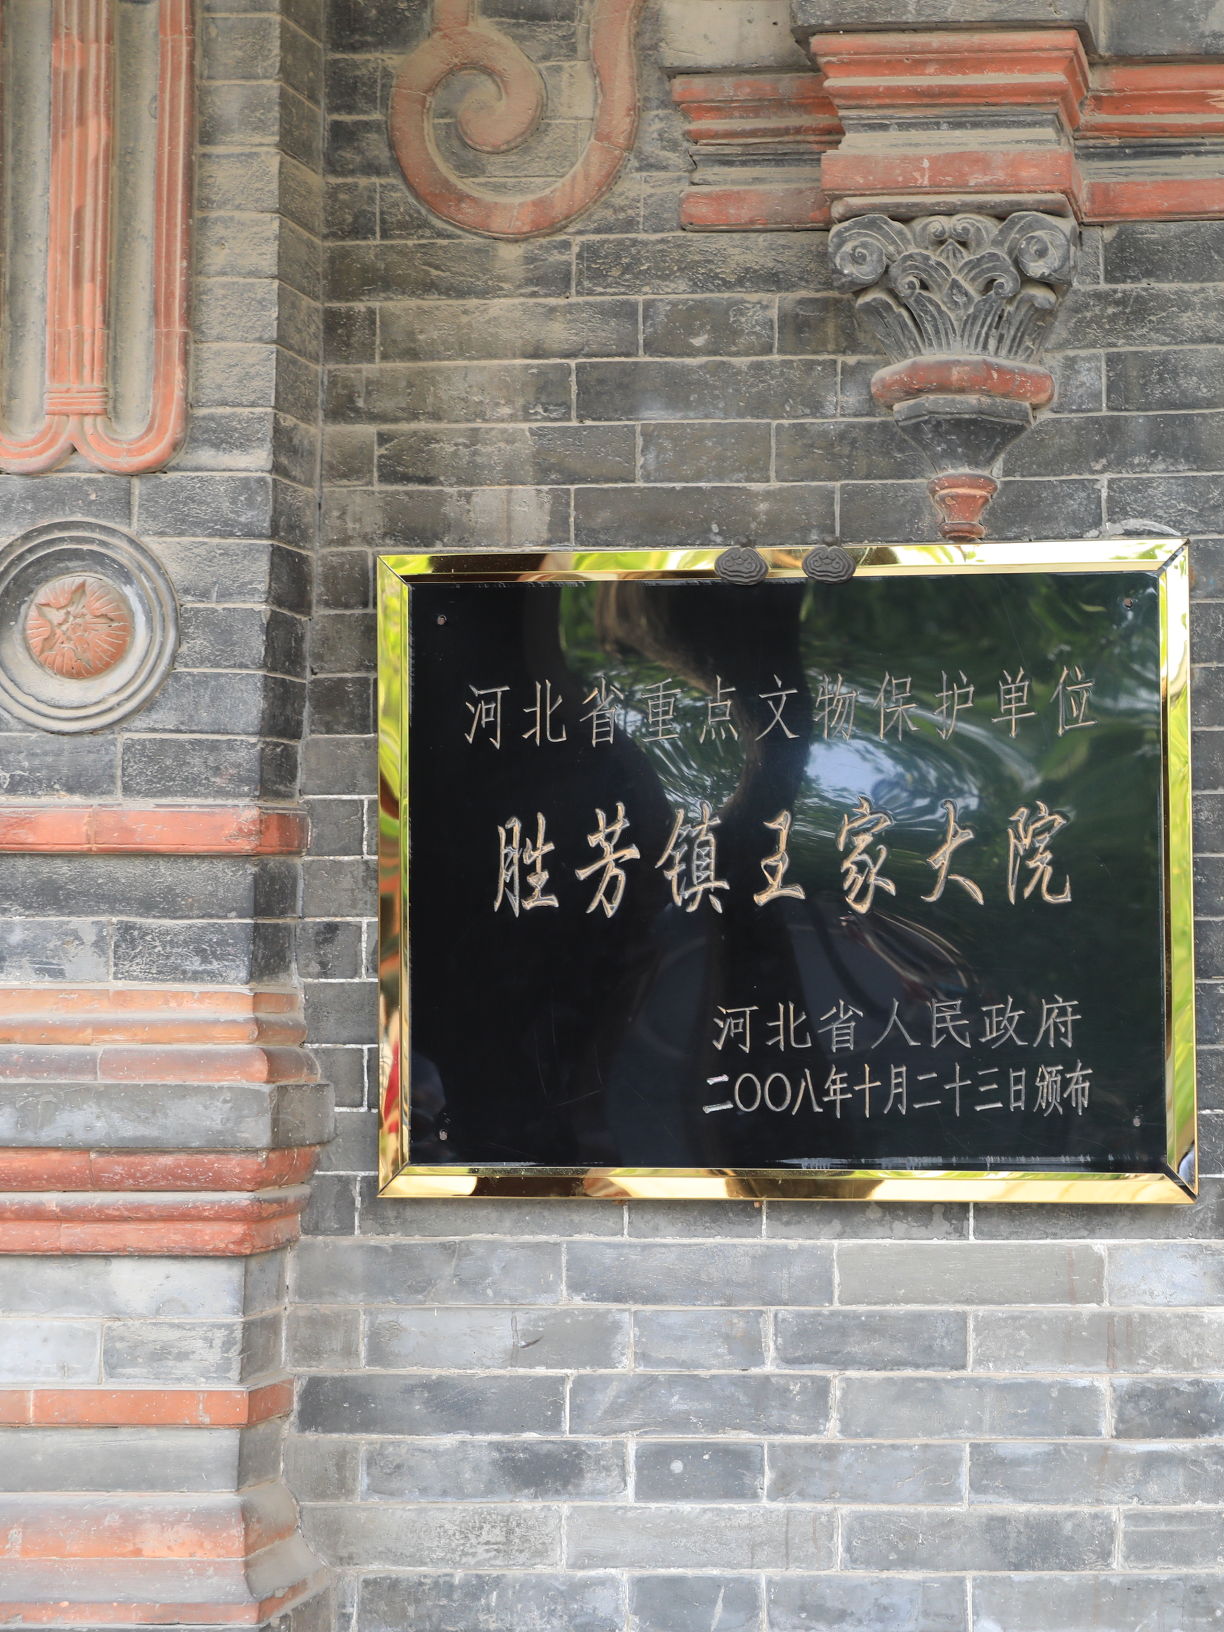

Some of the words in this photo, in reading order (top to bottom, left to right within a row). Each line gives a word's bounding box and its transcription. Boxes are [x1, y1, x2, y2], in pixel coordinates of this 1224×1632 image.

[464, 666, 1098, 749] 河北省重点文物保护单位
[494, 796, 1072, 918] 胜芳镇王家大院
[712, 995, 1083, 1053] 河北省人民政府
